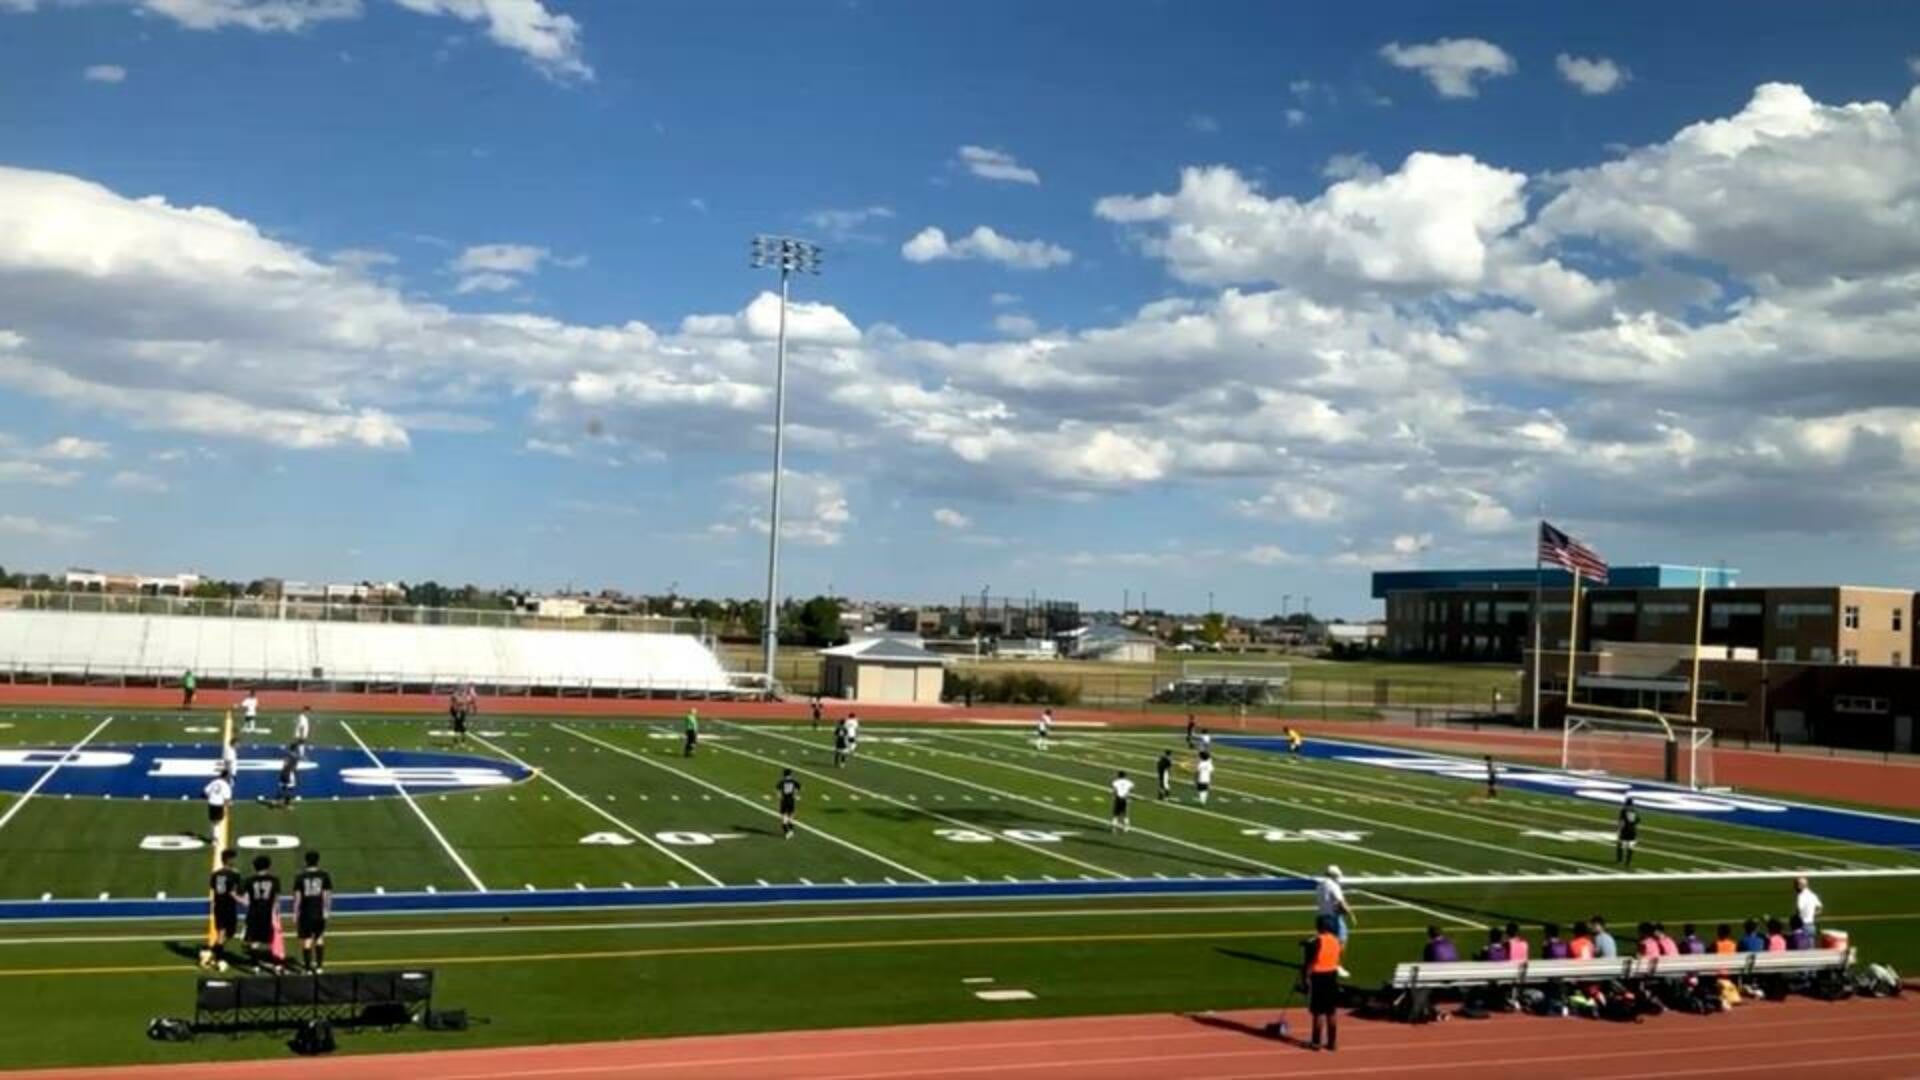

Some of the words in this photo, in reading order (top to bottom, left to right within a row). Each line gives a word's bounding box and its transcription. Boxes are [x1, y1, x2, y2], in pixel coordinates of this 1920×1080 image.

[139, 834, 300, 850] 50
[578, 831, 716, 845] 40
[253, 880, 273, 900] 17
